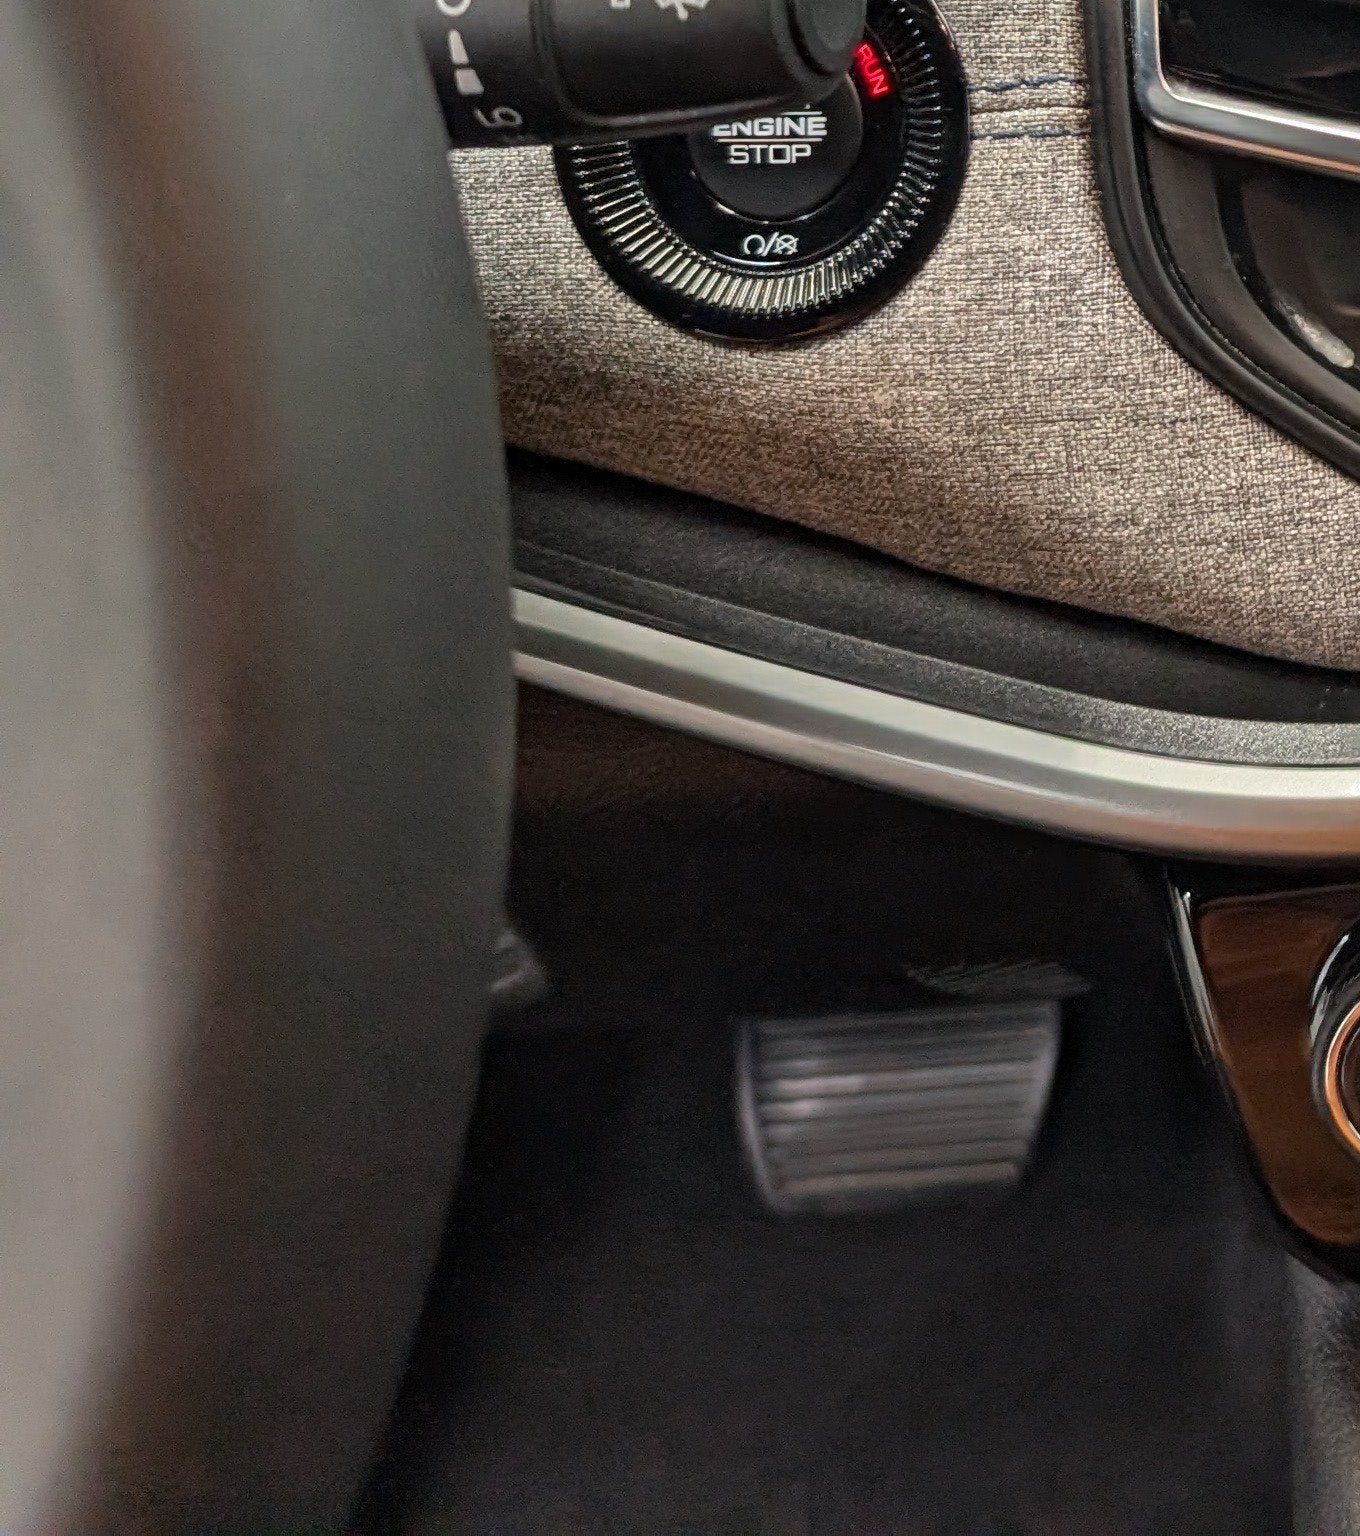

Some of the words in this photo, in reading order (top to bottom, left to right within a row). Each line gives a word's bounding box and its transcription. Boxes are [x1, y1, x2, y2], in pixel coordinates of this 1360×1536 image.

[854, 43, 890, 97] RUN
[710, 116, 828, 137] ENGINE
[728, 143, 812, 165] STOP
